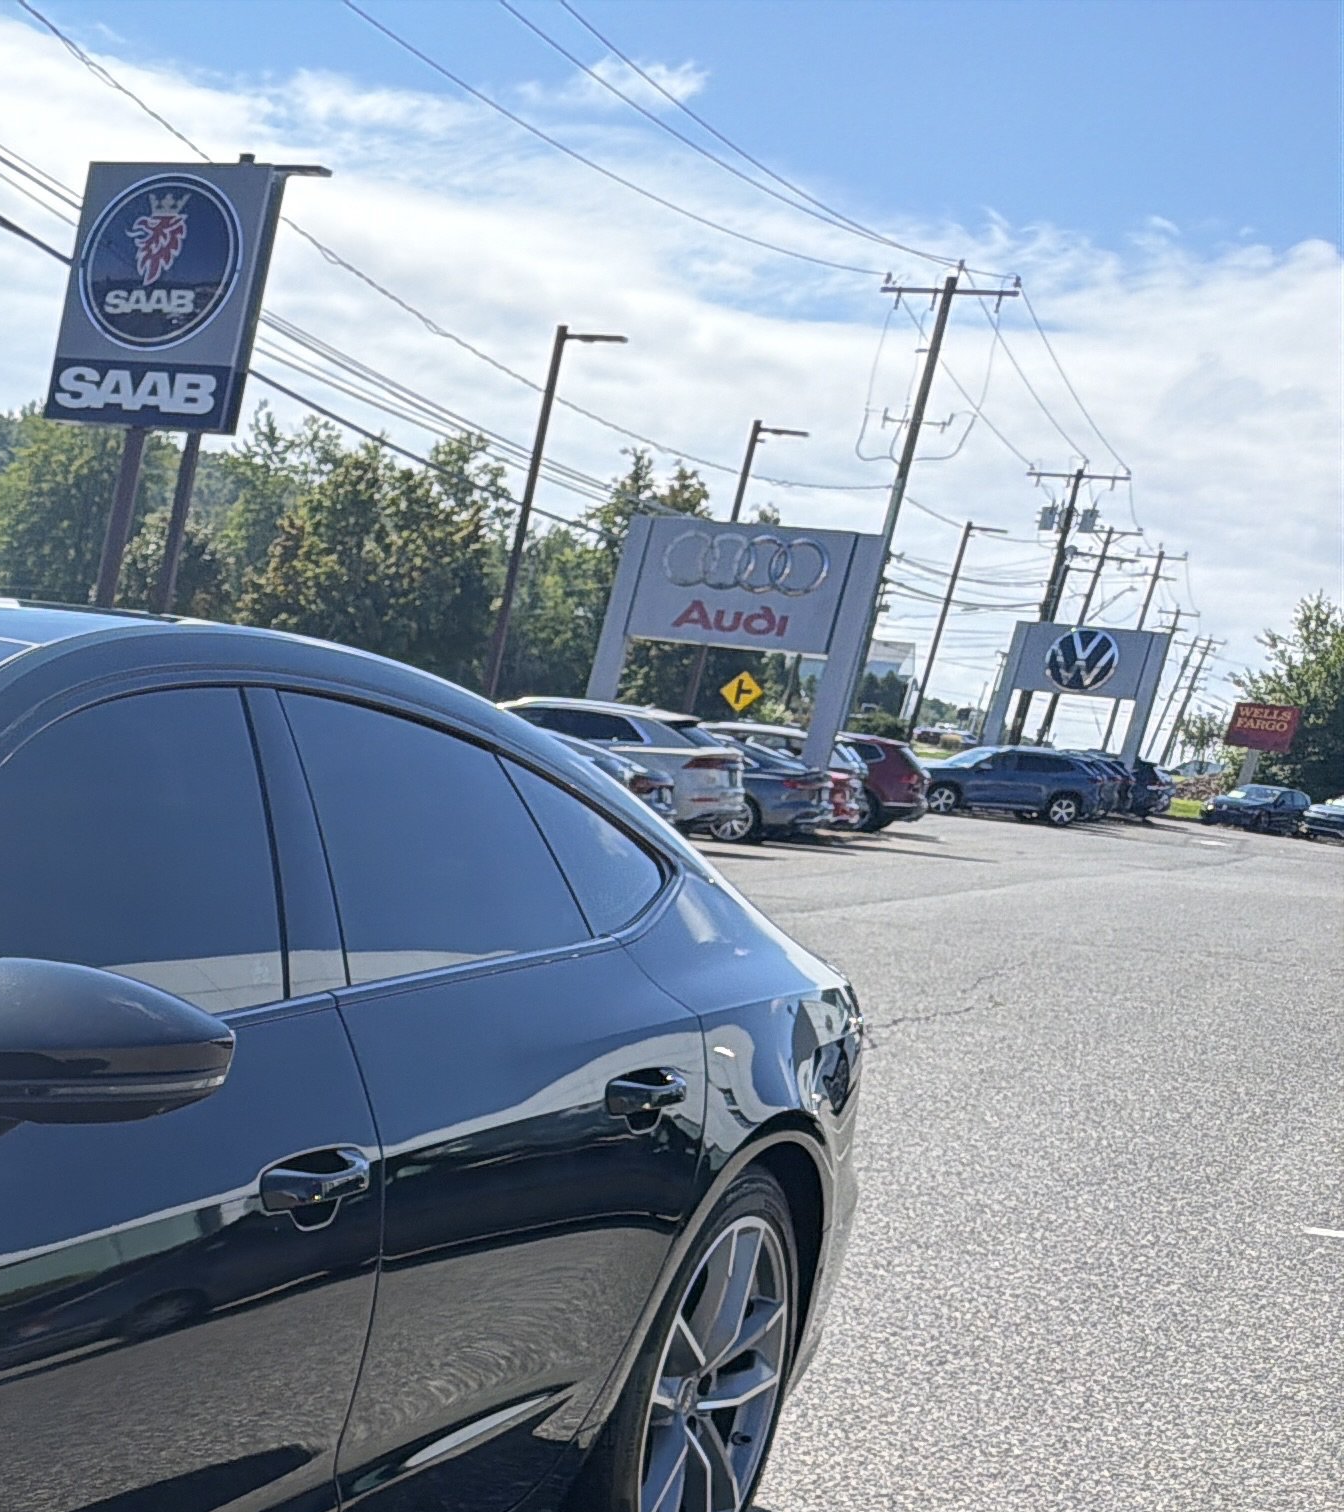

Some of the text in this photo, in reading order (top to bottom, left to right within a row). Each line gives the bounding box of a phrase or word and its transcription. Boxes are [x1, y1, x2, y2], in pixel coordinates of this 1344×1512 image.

[103, 288, 195, 315] SAAB
[54, 366, 218, 416] SAAB
[671, 599, 790, 637] Audi
[1235, 717, 1289, 732] FARGO
[1238, 706, 1293, 722] WELLS
